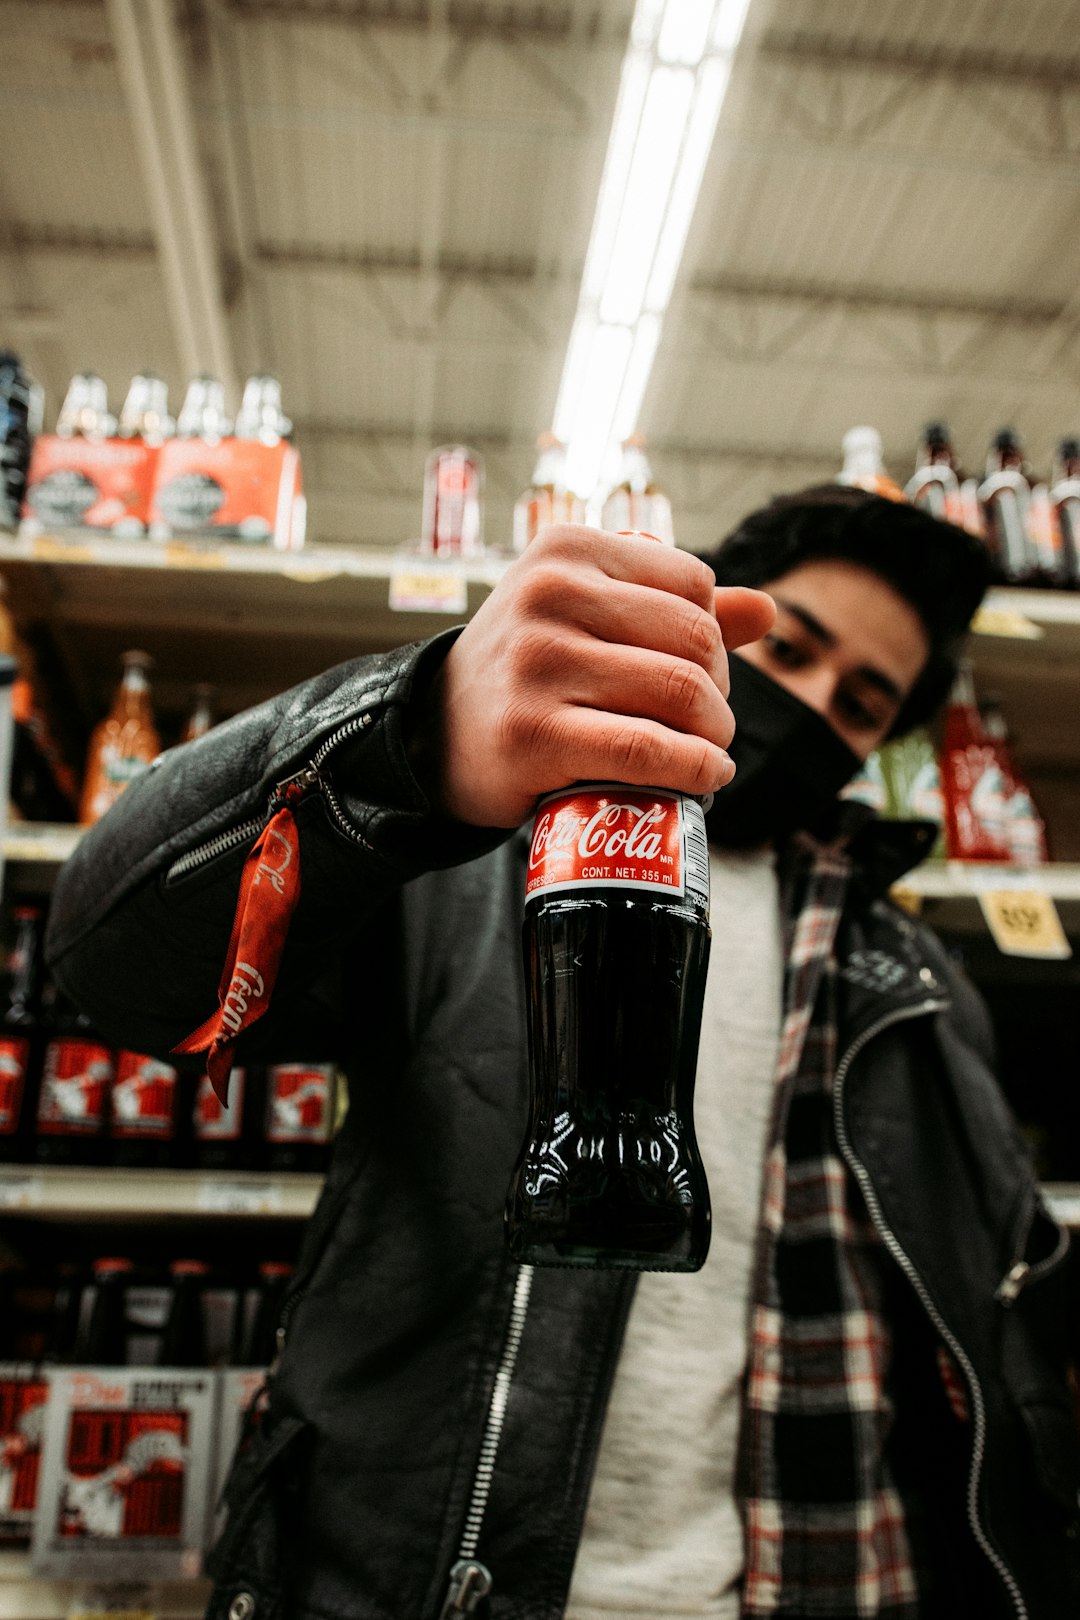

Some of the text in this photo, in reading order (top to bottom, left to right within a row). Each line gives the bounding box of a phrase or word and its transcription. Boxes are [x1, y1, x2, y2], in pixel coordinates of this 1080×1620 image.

[529, 803, 667, 870] Coca-Cola
[660, 855, 673, 865] MR
[581, 866, 673, 884] CONT. NET. 355 ml
